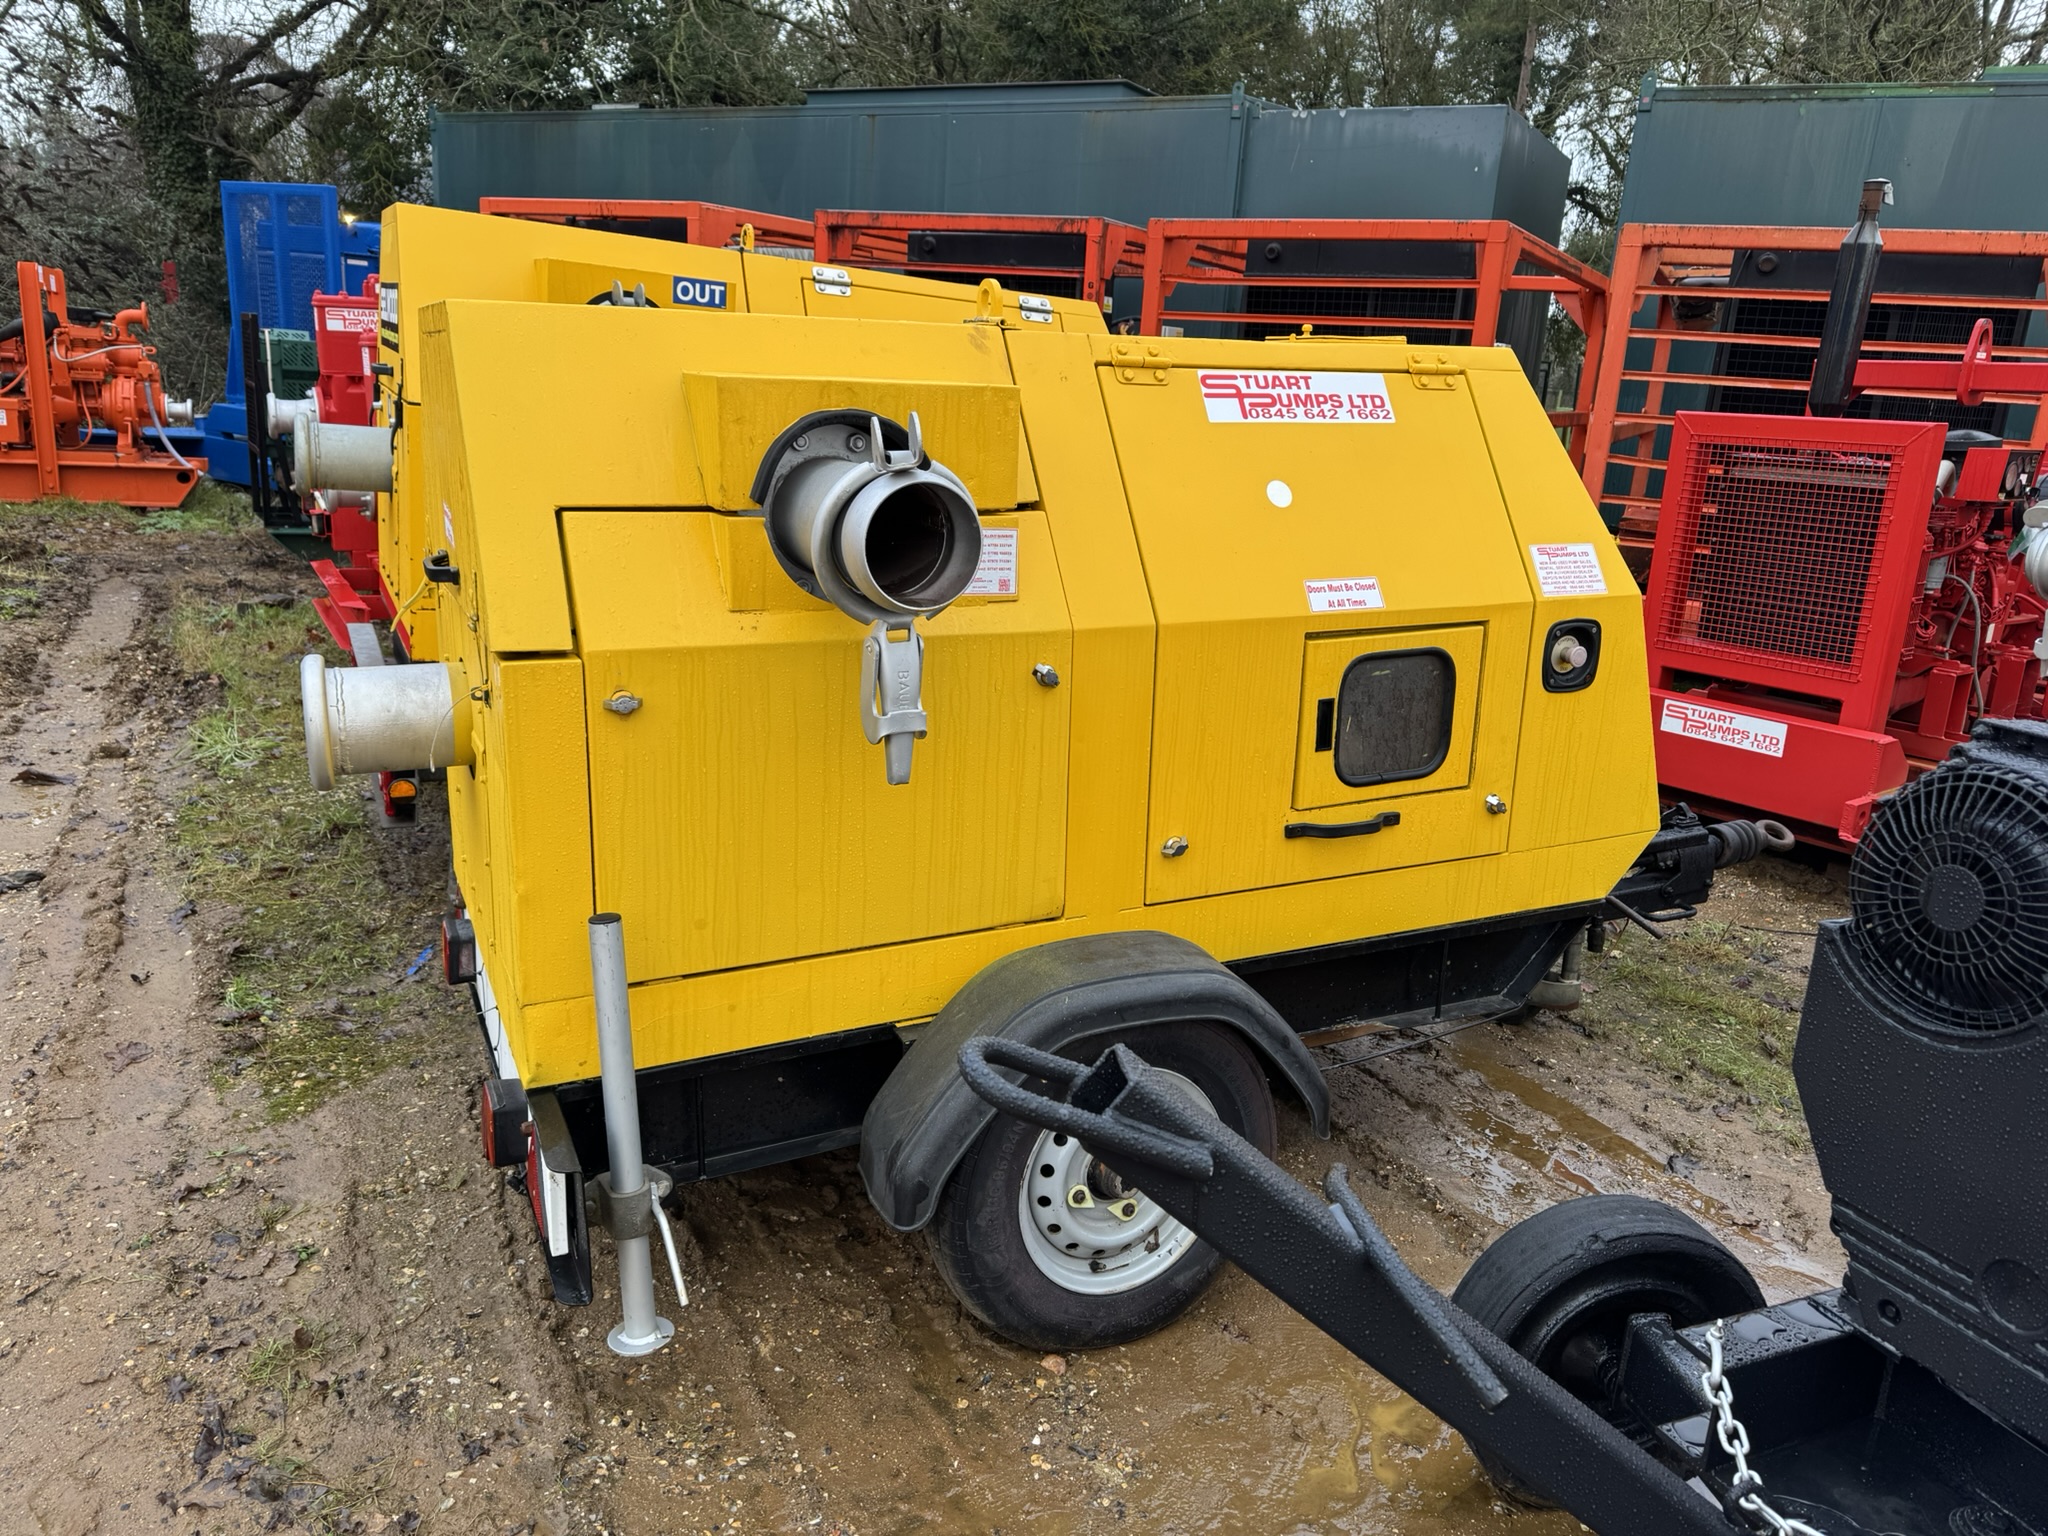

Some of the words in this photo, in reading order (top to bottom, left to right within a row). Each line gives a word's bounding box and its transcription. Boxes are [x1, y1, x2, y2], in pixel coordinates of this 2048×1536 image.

[676, 281, 725, 304] OUT
[1200, 374, 1312, 392] STUART
[1203, 391, 1344, 419] PUMPS
[1348, 394, 1386, 409] LTD
[1248, 408, 1298, 420] 0845
[1304, 408, 1339, 420] 642
[1346, 408, 1393, 420] 1662
[1307, 585, 1326, 594] Doors
[1326, 584, 1344, 592] Must
[1344, 582, 1354, 592] Be
[1354, 582, 1376, 591] Closed
[1328, 599, 1336, 608] At
[1337, 598, 1346, 608] All
[1346, 598, 1367, 607] Times
[1666, 703, 1736, 725] STUART
[1665, 713, 1750, 740] PUMPS
[1753, 732, 1781, 747] LTD
[1686, 726, 1717, 739] 0845
[1720, 734, 1744, 746] 642
[1749, 740, 1781, 754] 1662
